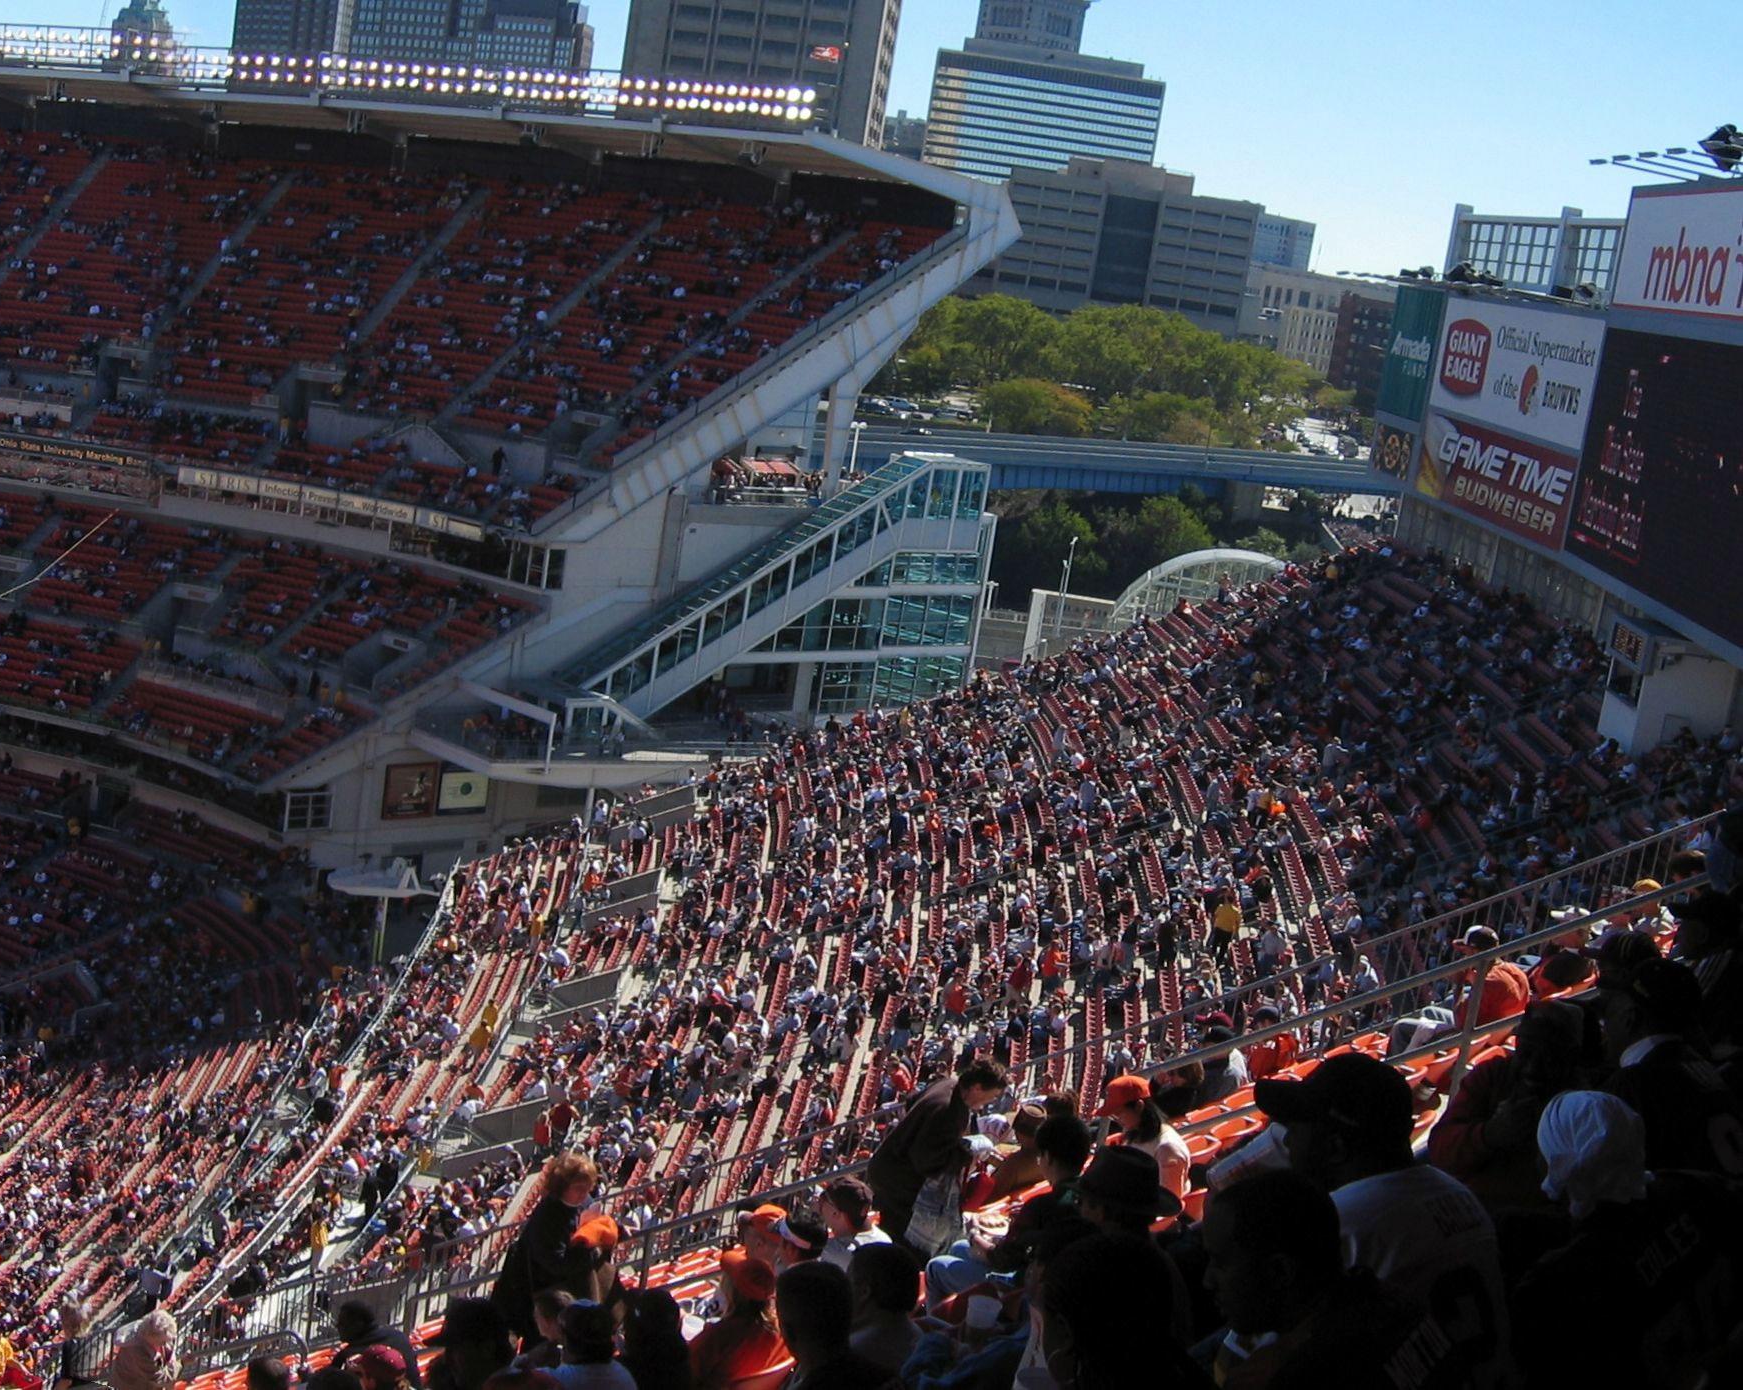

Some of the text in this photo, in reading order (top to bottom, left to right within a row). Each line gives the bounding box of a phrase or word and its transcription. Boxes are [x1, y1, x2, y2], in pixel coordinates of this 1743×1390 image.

[1643, 226, 1730, 306] mbna
[1391, 331, 1431, 362] Armada
[1449, 329, 1488, 358] GIANT
[1497, 325, 1596, 367] Official Supermarket
[1444, 355, 1482, 384] EAGLE
[1493, 373, 1519, 400] of the
[1542, 380, 1581, 415] BROWNS
[0, 437, 17, 449] Ohio
[20, 440, 41, 452] State
[43, 443, 84, 460] University
[85, 450, 124, 466] Marching
[1439, 432, 1573, 505] GAME TIME
[264, 483, 306, 500] Infection
[1454, 476, 1557, 535] BUDWEISER
